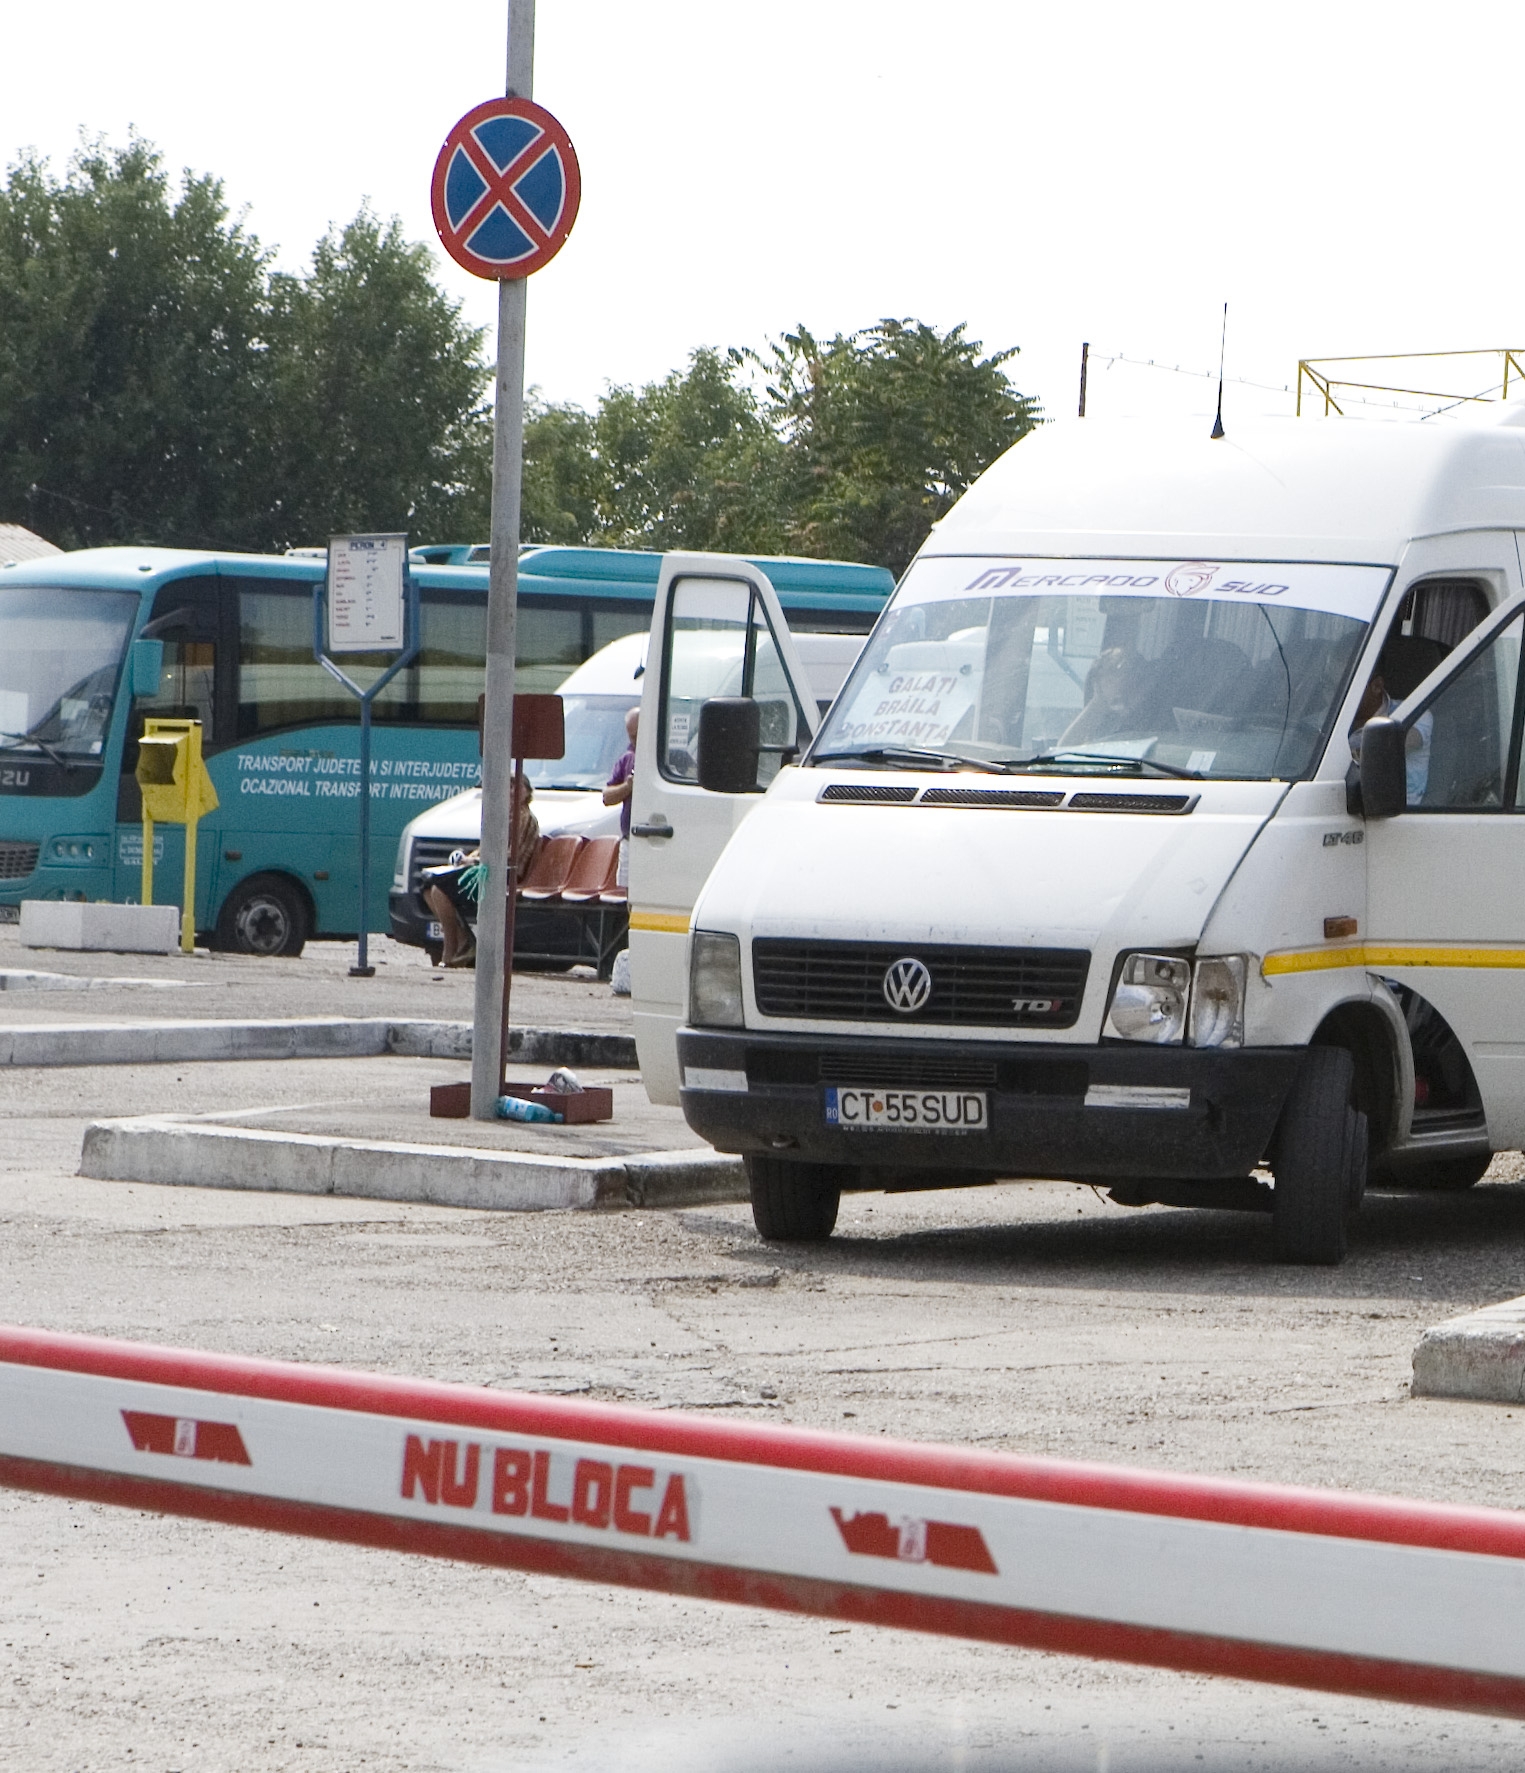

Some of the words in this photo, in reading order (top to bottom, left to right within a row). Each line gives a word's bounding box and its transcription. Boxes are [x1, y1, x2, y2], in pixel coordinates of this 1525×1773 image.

[1214, 580, 1290, 596] SUD
[237, 754, 313, 772] TRANSPORT
[313, 758, 379, 775] JUDETEN
[380, 760, 393, 776] SI
[394, 760, 484, 779] INTERJUDETEA
[0, 770, 30, 786] ZU
[240, 778, 311, 796] OCAZIONAL
[315, 780, 389, 798] TRANSPRT
[389, 783, 468, 800] INTERNATIO
[1011, 999, 1063, 1011] TDI
[826, 1107, 838, 1119] RO
[400, 1433, 481, 1508] NU
[491, 1446, 692, 1543] BLOCA
